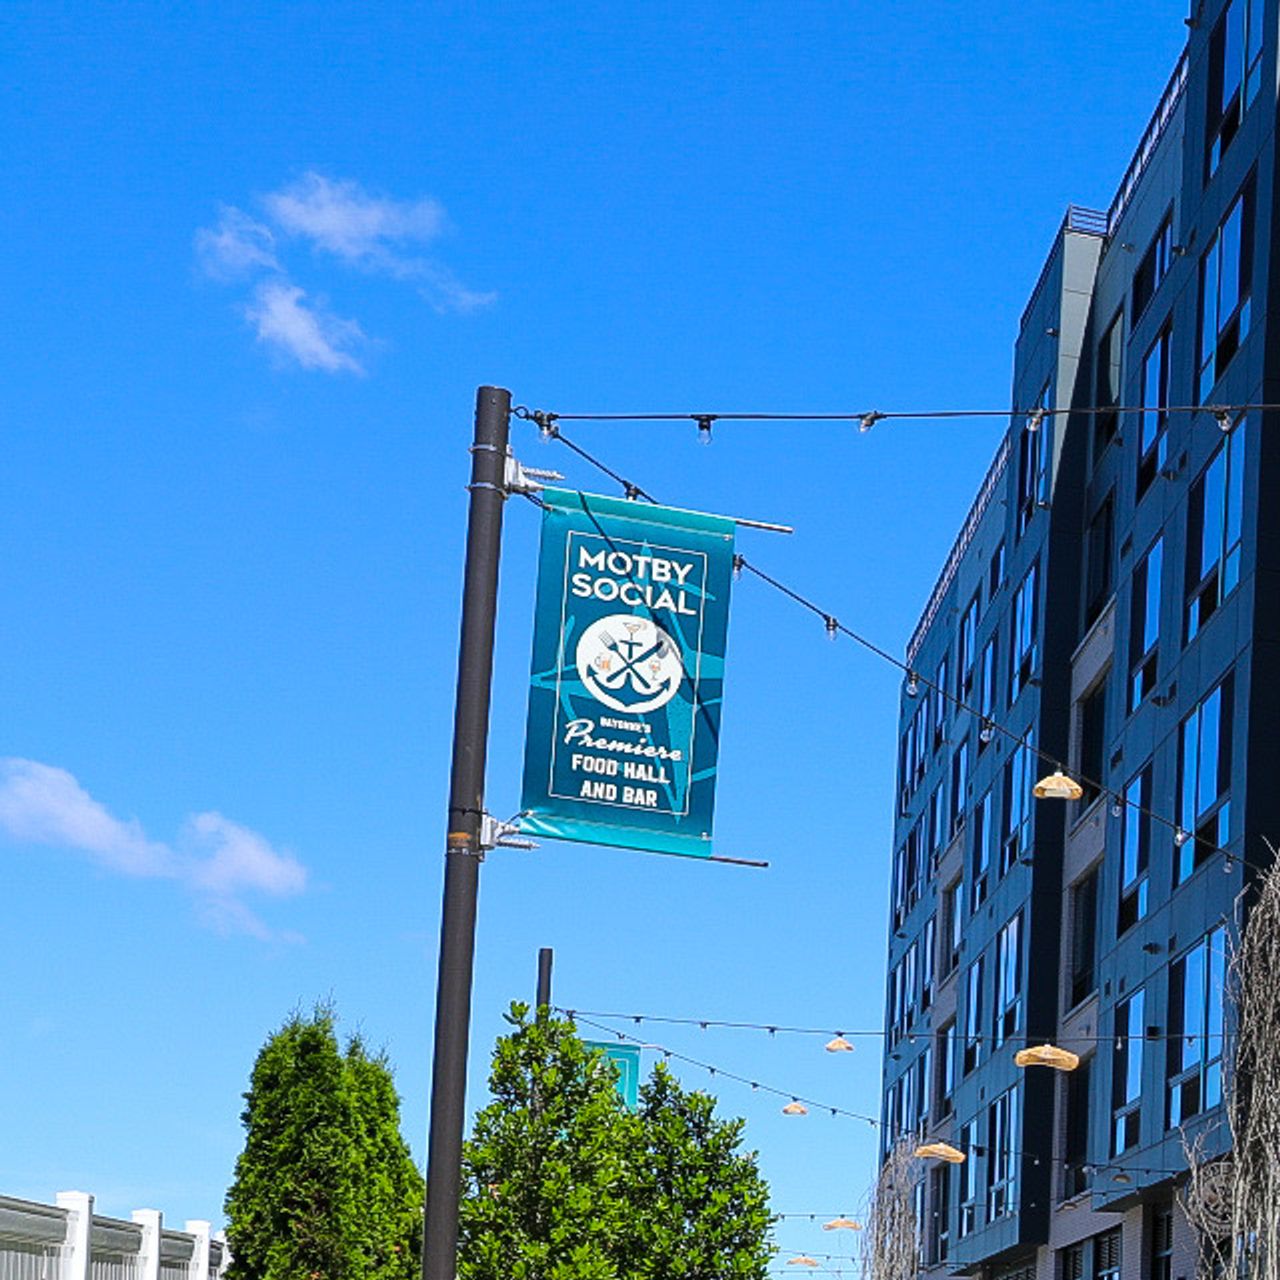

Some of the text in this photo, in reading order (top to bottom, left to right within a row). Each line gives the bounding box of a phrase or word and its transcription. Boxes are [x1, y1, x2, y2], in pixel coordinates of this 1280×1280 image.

[578, 546, 693, 585] MOTBY
[572, 573, 697, 615] SOCIAL
[564, 719, 682, 761] Premiere
[572, 754, 671, 784] FOOD HALL
[580, 780, 657, 807] AND BAR
